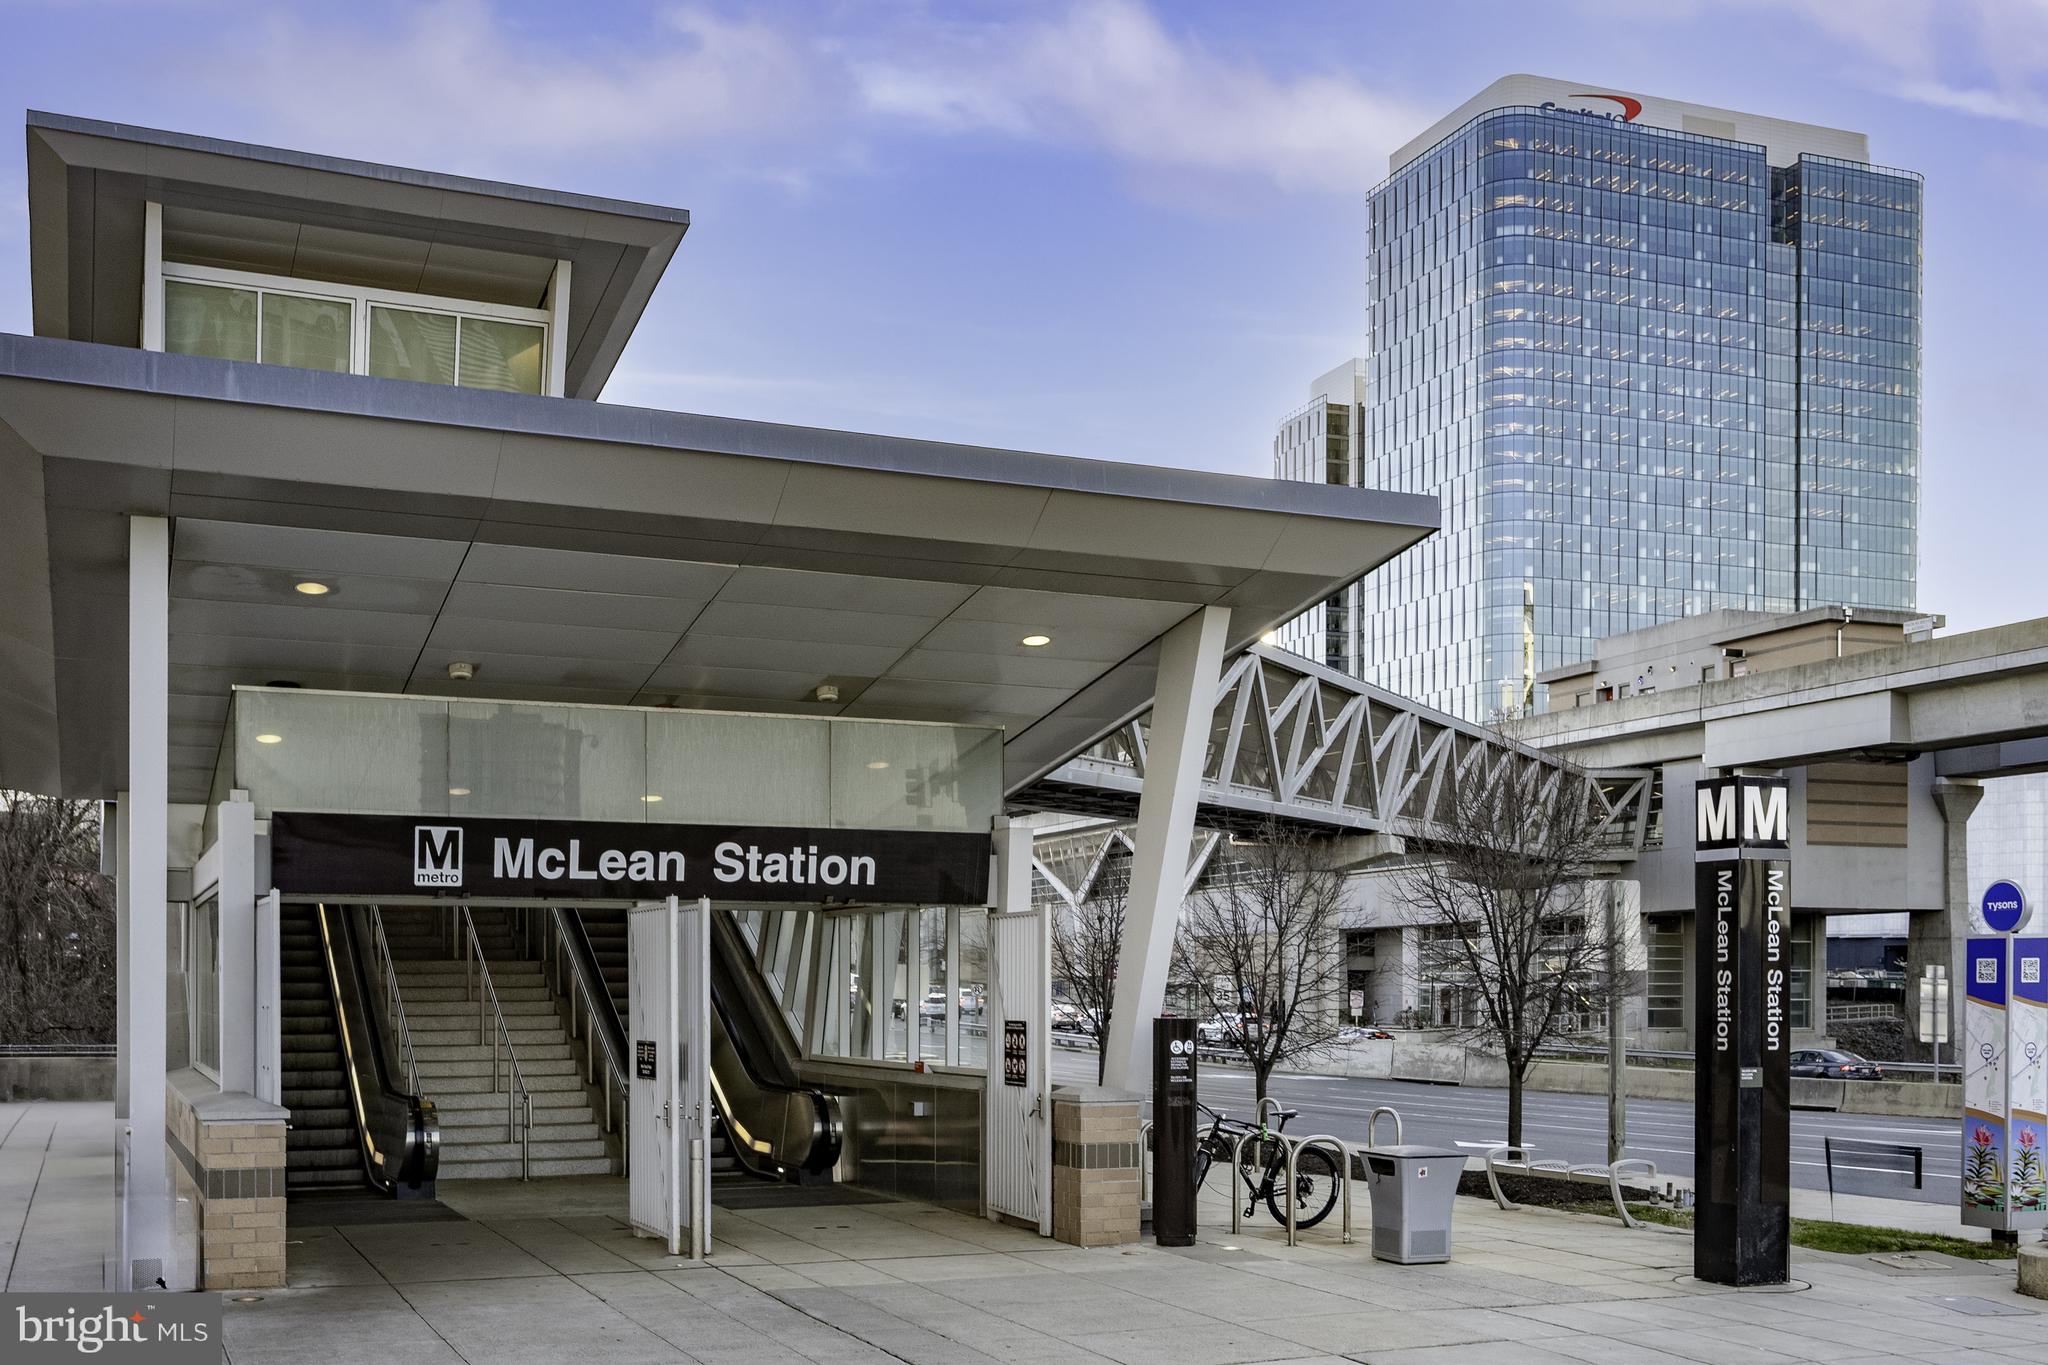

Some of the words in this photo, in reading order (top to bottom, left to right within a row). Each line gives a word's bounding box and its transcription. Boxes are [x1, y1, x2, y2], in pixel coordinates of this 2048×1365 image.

[1698, 786, 1736, 841] M
[1744, 786, 1787, 840] M
[418, 829, 459, 869] M
[494, 837, 686, 882] McLean
[713, 841, 876, 885] Station
[417, 872, 459, 883] metro
[1717, 870, 1732, 962] McLean
[1768, 870, 1784, 962] McLean
[1717, 970, 1732, 1051] Station
[1767, 969, 1783, 1051] Station
